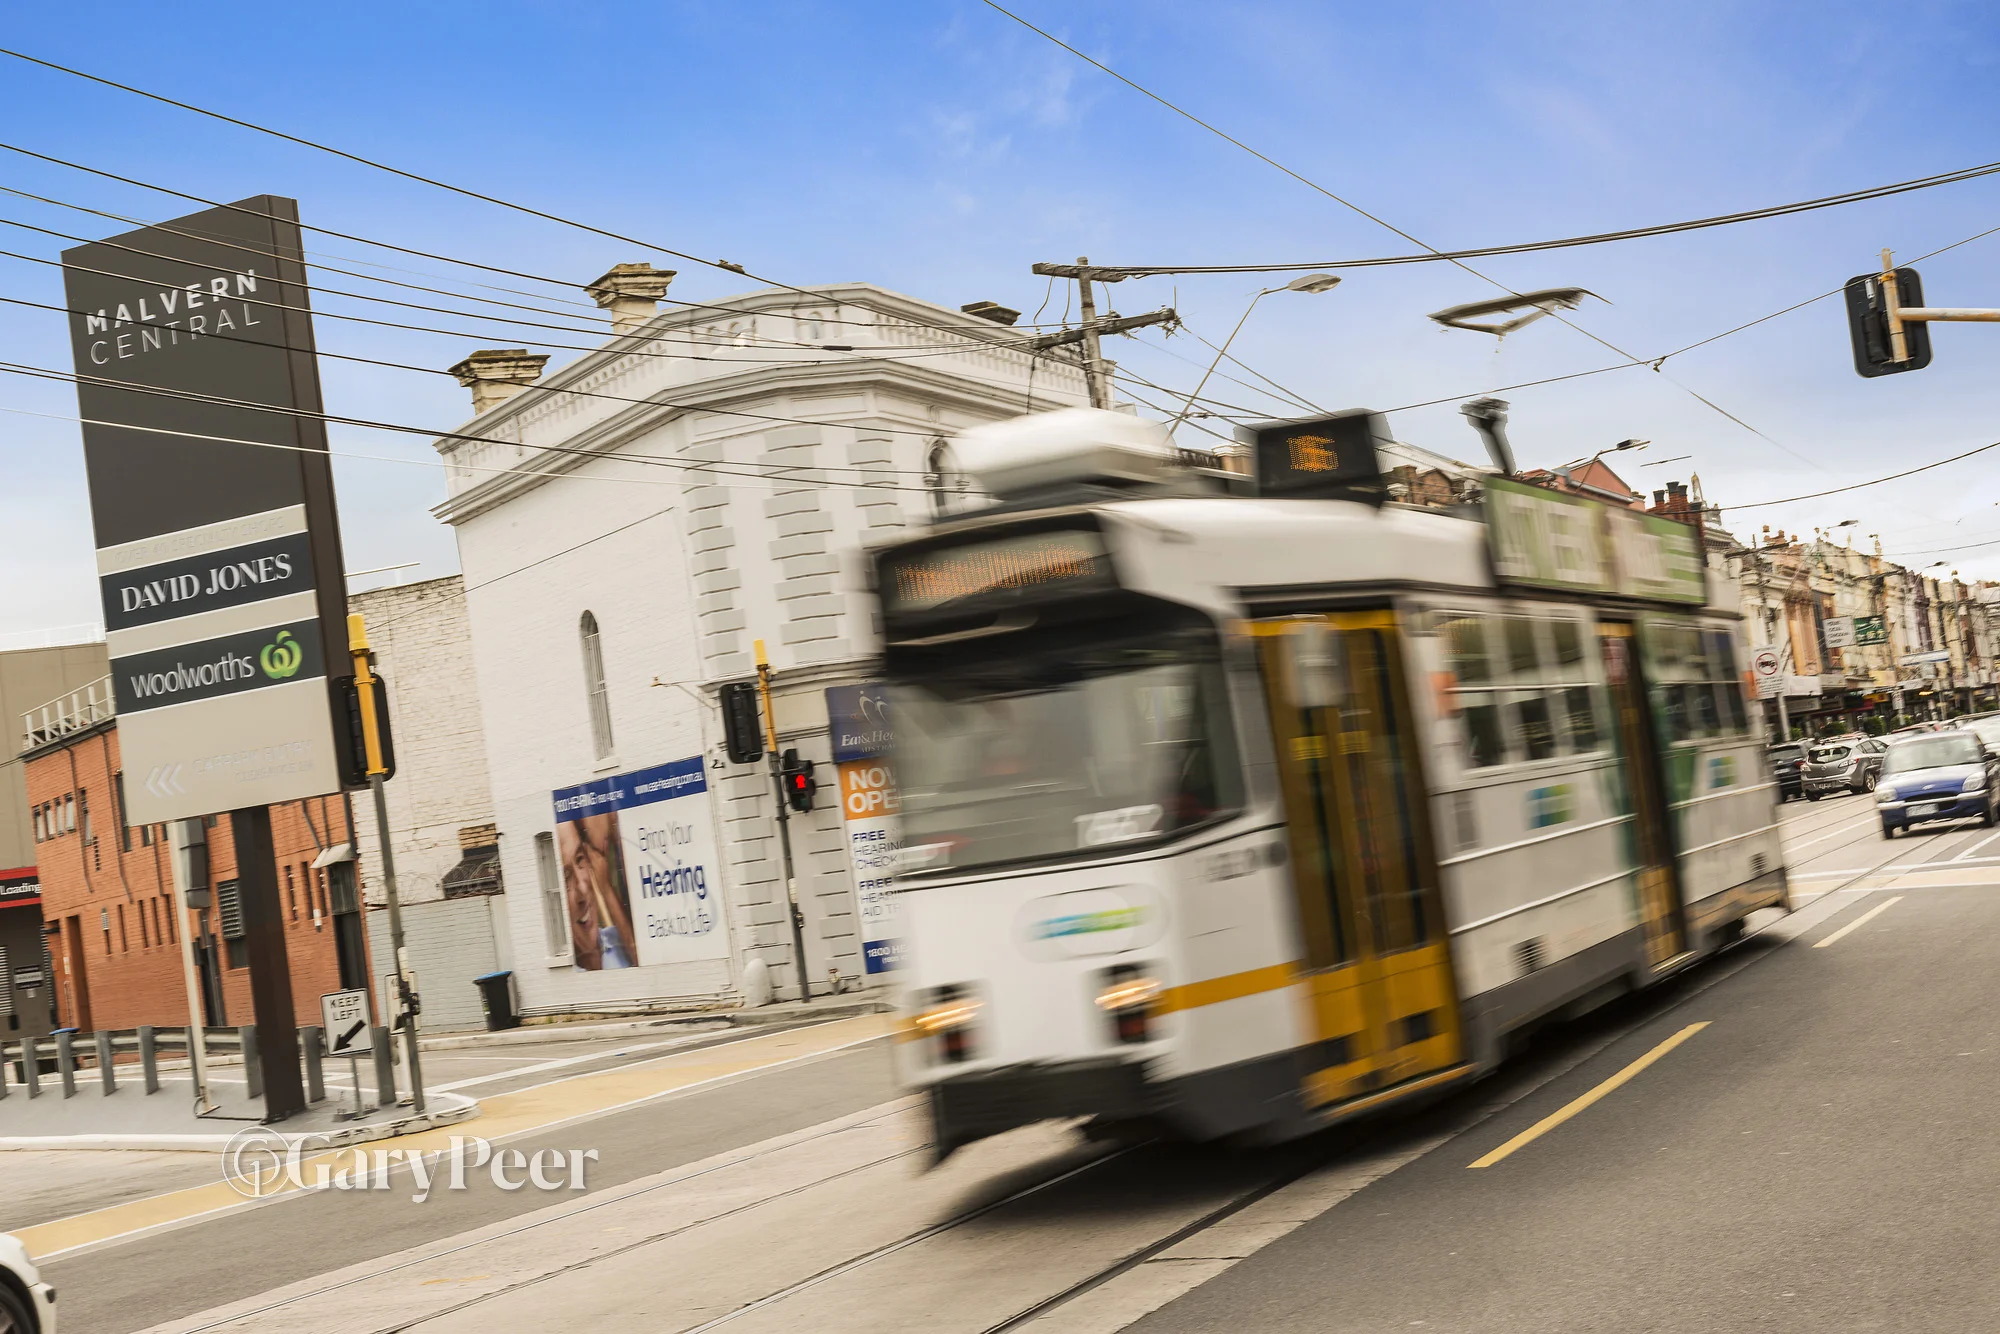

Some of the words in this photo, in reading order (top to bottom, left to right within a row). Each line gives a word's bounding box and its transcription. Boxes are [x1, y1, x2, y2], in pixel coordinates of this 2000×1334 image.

[86, 269, 257, 335] MALVERN
[90, 303, 261, 365] CENTRAL
[120, 573, 200, 613] DAVID
[205, 553, 293, 596] JONES
[638, 827, 668, 855] Bring
[666, 820, 694, 846] Your
[852, 829, 886, 844] FREE
[0, 882, 42, 896] Loading
[639, 859, 708, 900] Hearing
[859, 876, 893, 891] FREE
[647, 911, 673, 938] Back
[329, 995, 360, 1009] KEEP
[332, 1008, 361, 1021] LEFT
